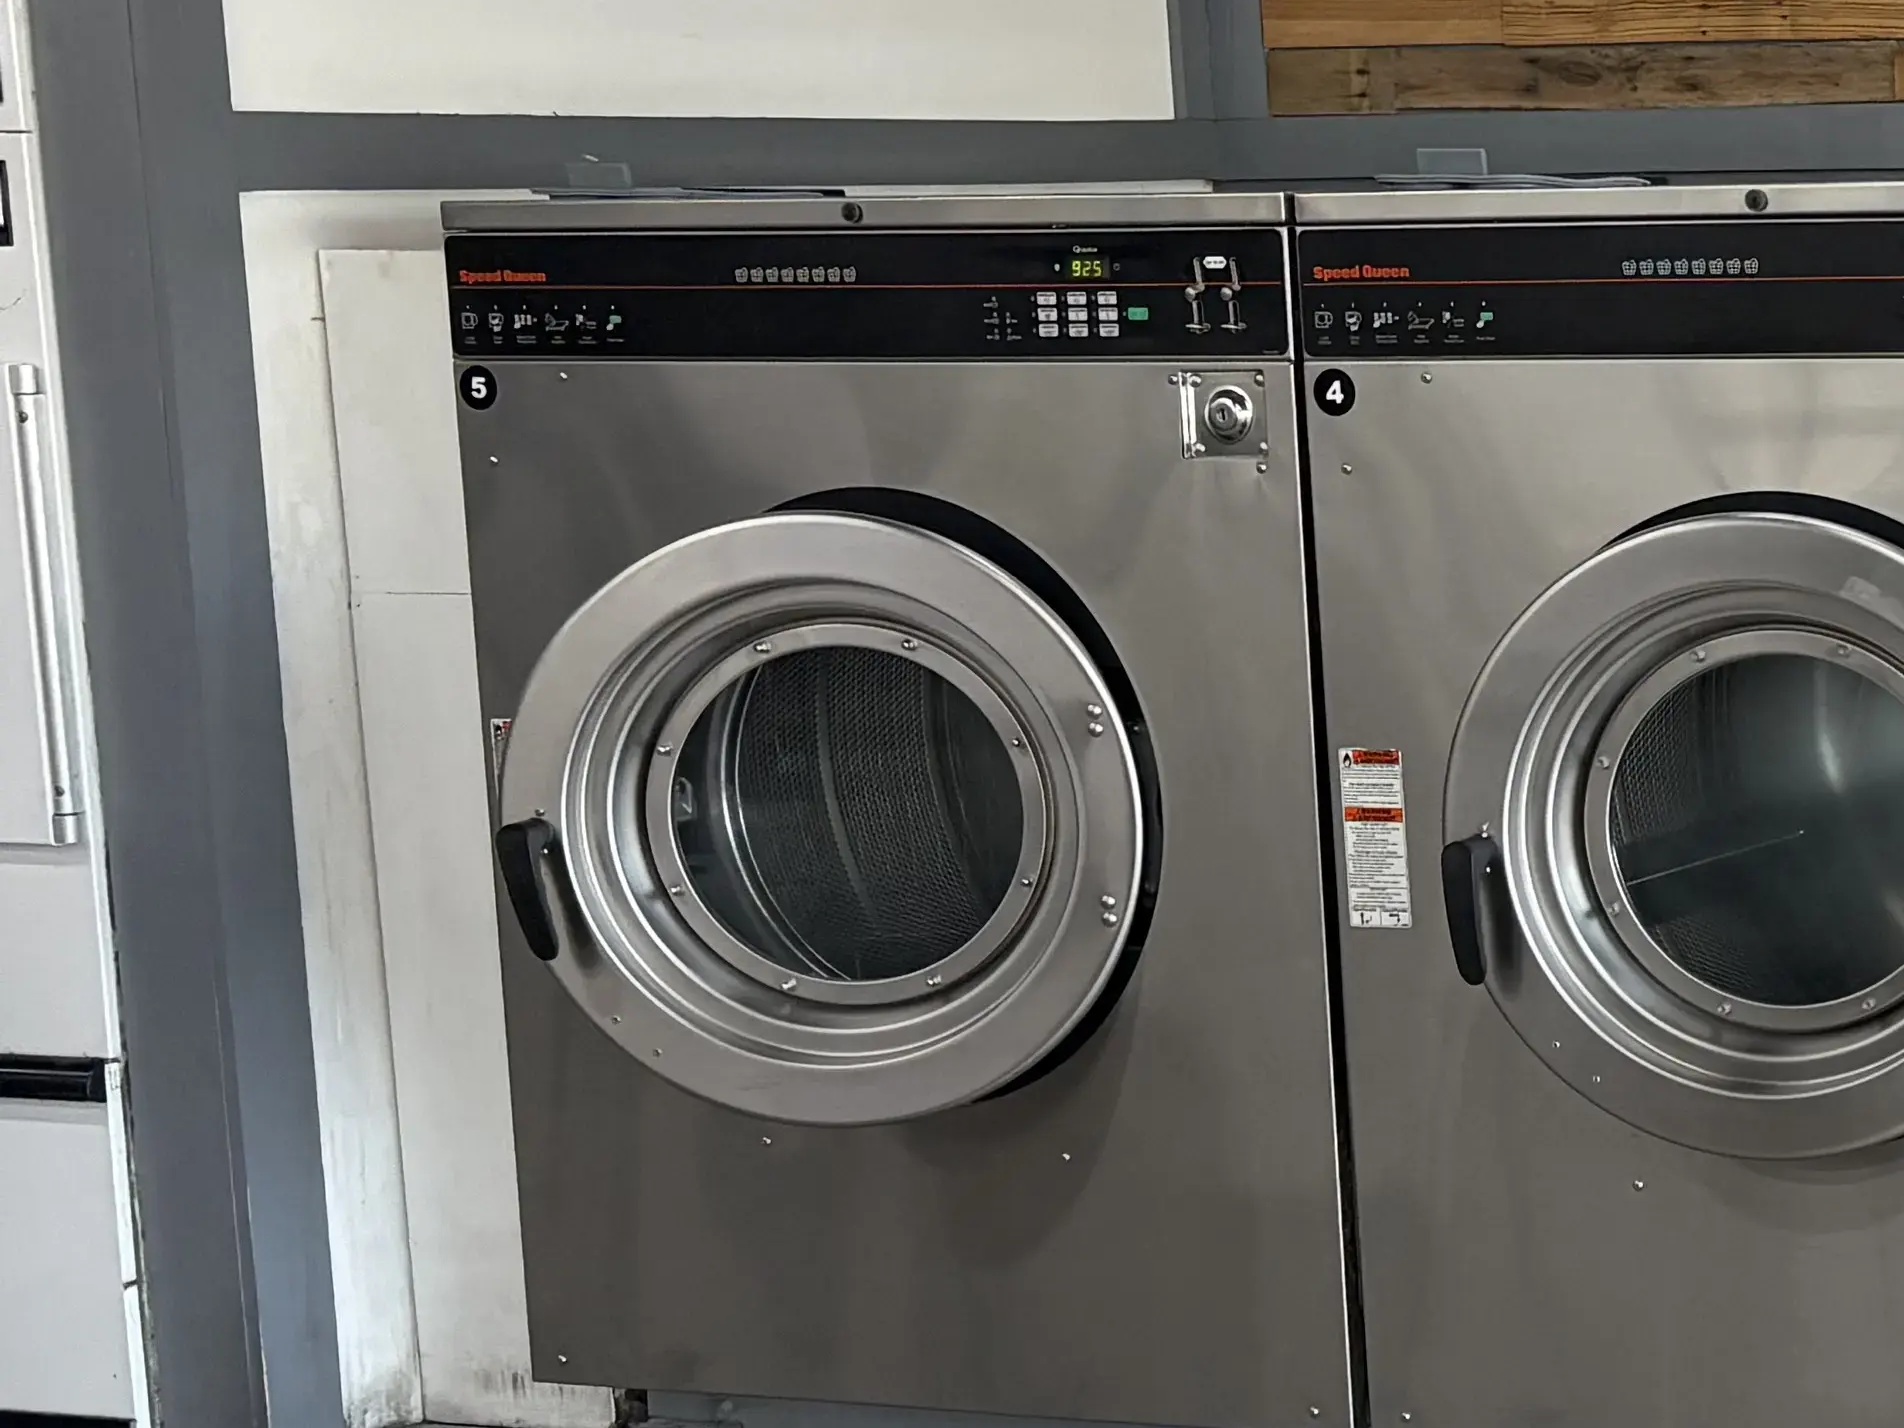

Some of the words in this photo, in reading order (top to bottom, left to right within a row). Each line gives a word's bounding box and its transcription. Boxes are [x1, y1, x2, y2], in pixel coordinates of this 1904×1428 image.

[1072, 260, 1102, 277] 925
[1313, 265, 1360, 281] Speed
[1362, 264, 1410, 278] Queen
[471, 376, 488, 399] 5
[1325, 380, 1345, 404] 4
